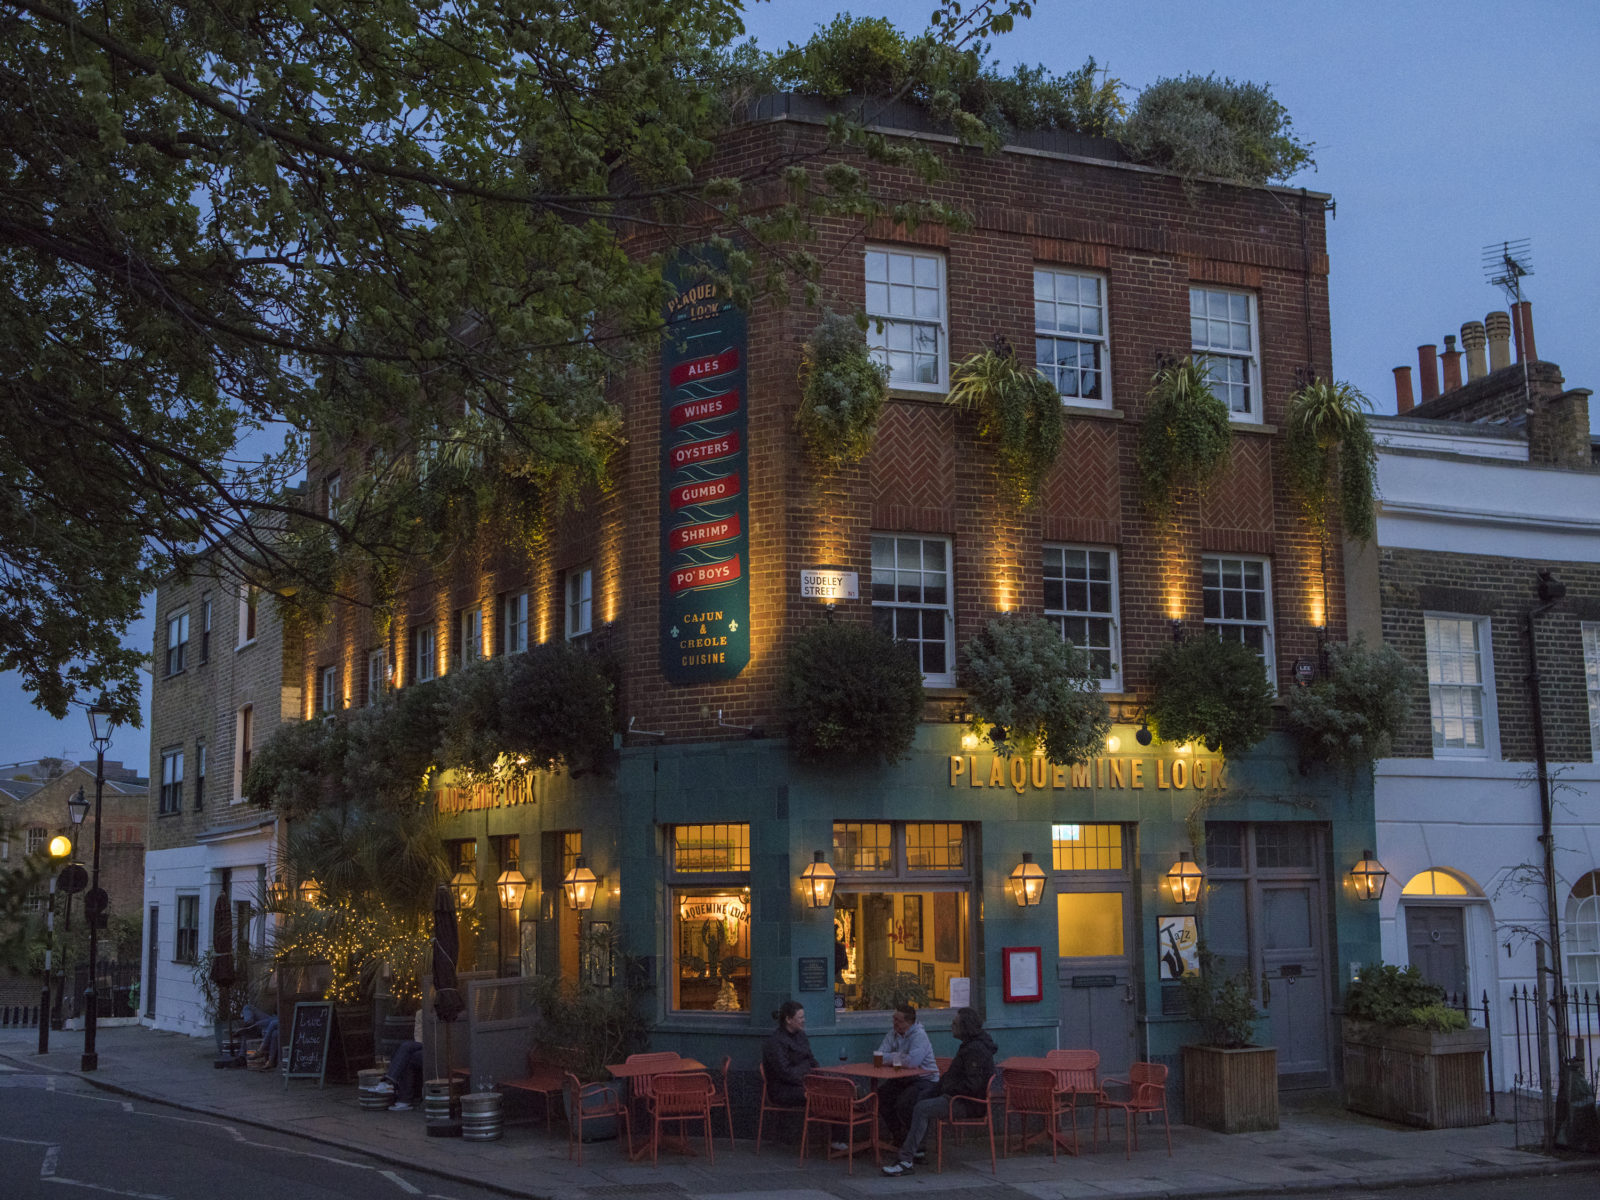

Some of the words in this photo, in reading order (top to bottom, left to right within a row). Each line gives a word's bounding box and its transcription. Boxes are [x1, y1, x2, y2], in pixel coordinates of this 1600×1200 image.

[688, 360, 719, 376] ALES
[684, 400, 723, 418] WINES
[676, 441, 730, 461] OYSTERS
[682, 483, 726, 501] GUMBO
[681, 524, 729, 542] SHRIMP
[698, 566, 730, 580] BOYS
[804, 576, 843, 586] SUDELEY
[804, 586, 836, 596] STREET
[683, 611, 724, 624] CAJUN
[699, 623, 708, 635] &
[680, 636, 728, 649] CREOLE
[681, 652, 726, 667] CUISINE
[949, 755, 1144, 794] PLAQUEMINE
[1156, 759, 1228, 789] LOCK
